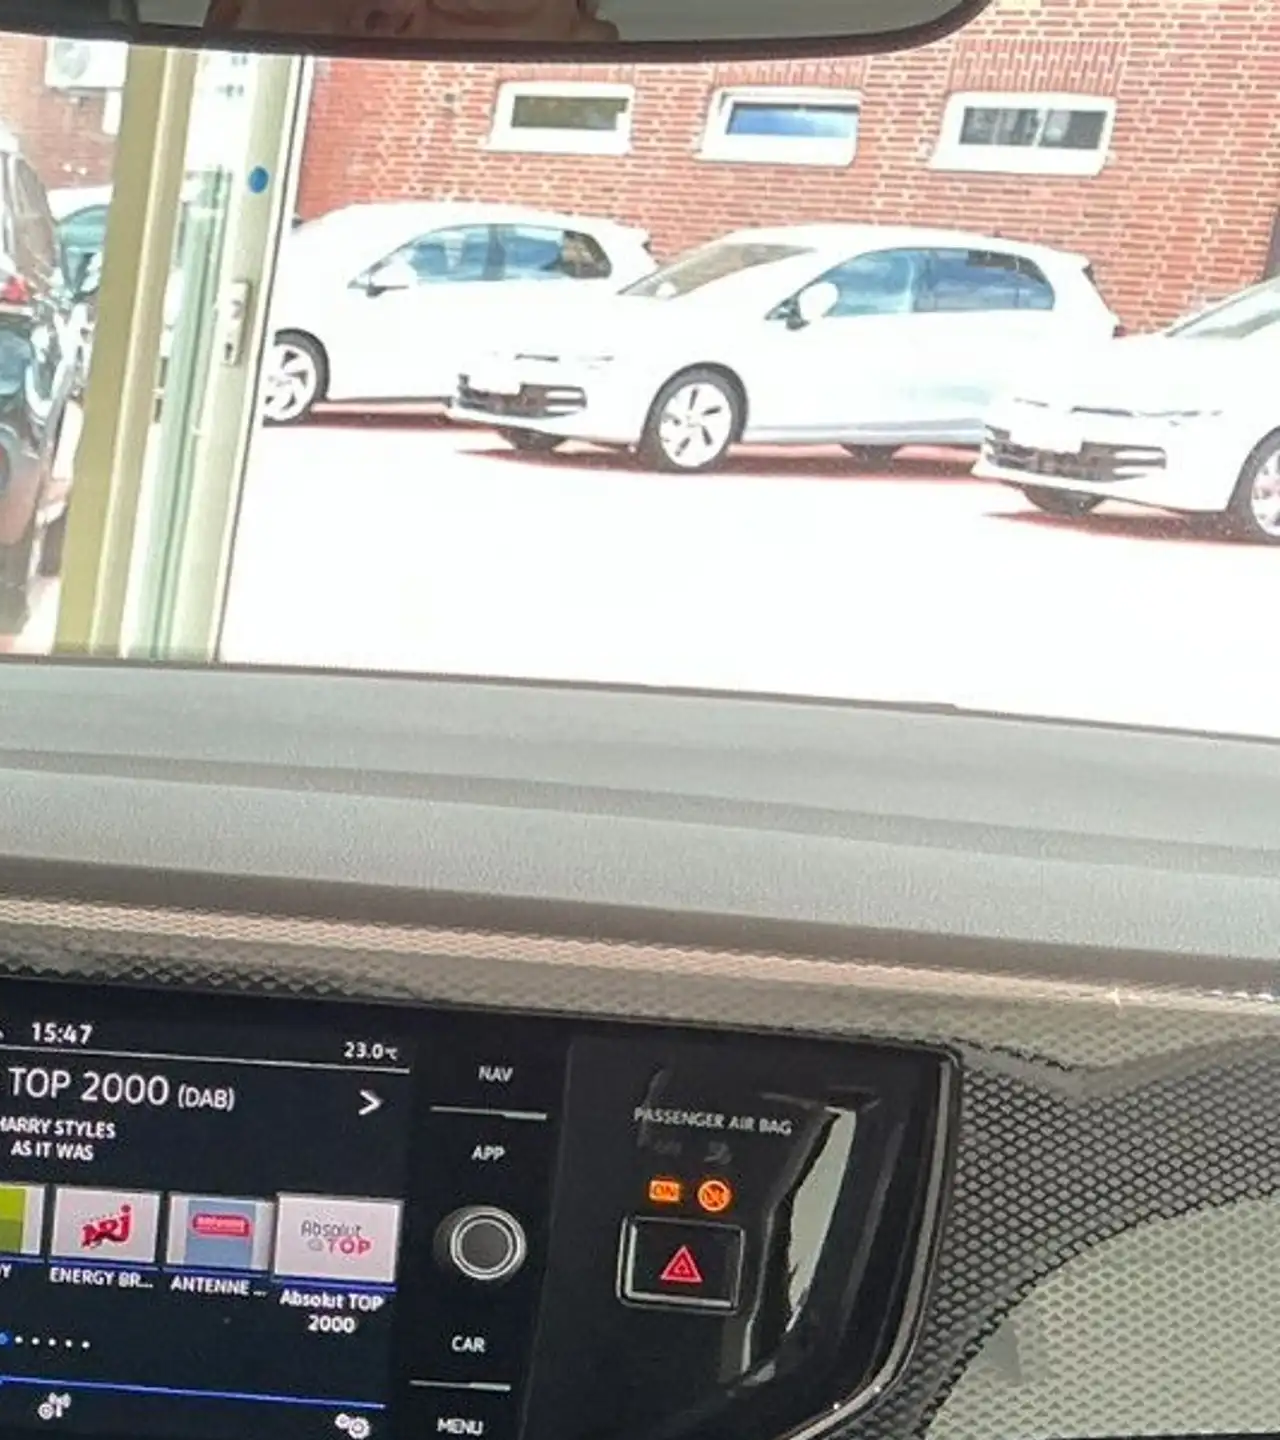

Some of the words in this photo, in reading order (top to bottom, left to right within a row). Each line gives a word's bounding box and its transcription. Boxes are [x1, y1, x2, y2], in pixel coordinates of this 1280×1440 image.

[32, 1022, 93, 1044] 15:47
[478, 1066, 513, 1083] NAV
[8, 1067, 71, 1099] TOP
[81, 1071, 170, 1105] 2000
[177, 1084, 235, 1112] (DAB)
[54, 1120, 116, 1139] STYLES
[634, 1107, 725, 1130] PASSENGER
[728, 1116, 755, 1131] AIR
[759, 1118, 793, 1136] BAG
[11, 1141, 32, 1157] AS
[36, 1143, 51, 1157] IT
[56, 1144, 95, 1161] WAS
[471, 1146, 505, 1161] APP
[49, 1268, 114, 1286] ENERGY
[170, 1276, 250, 1296] ANTENNE
[280, 1288, 343, 1309] Absolut
[348, 1292, 385, 1311] TOP
[307, 1317, 356, 1334] 2000
[451, 1336, 485, 1353] CAR
[436, 1417, 484, 1437] MENU
